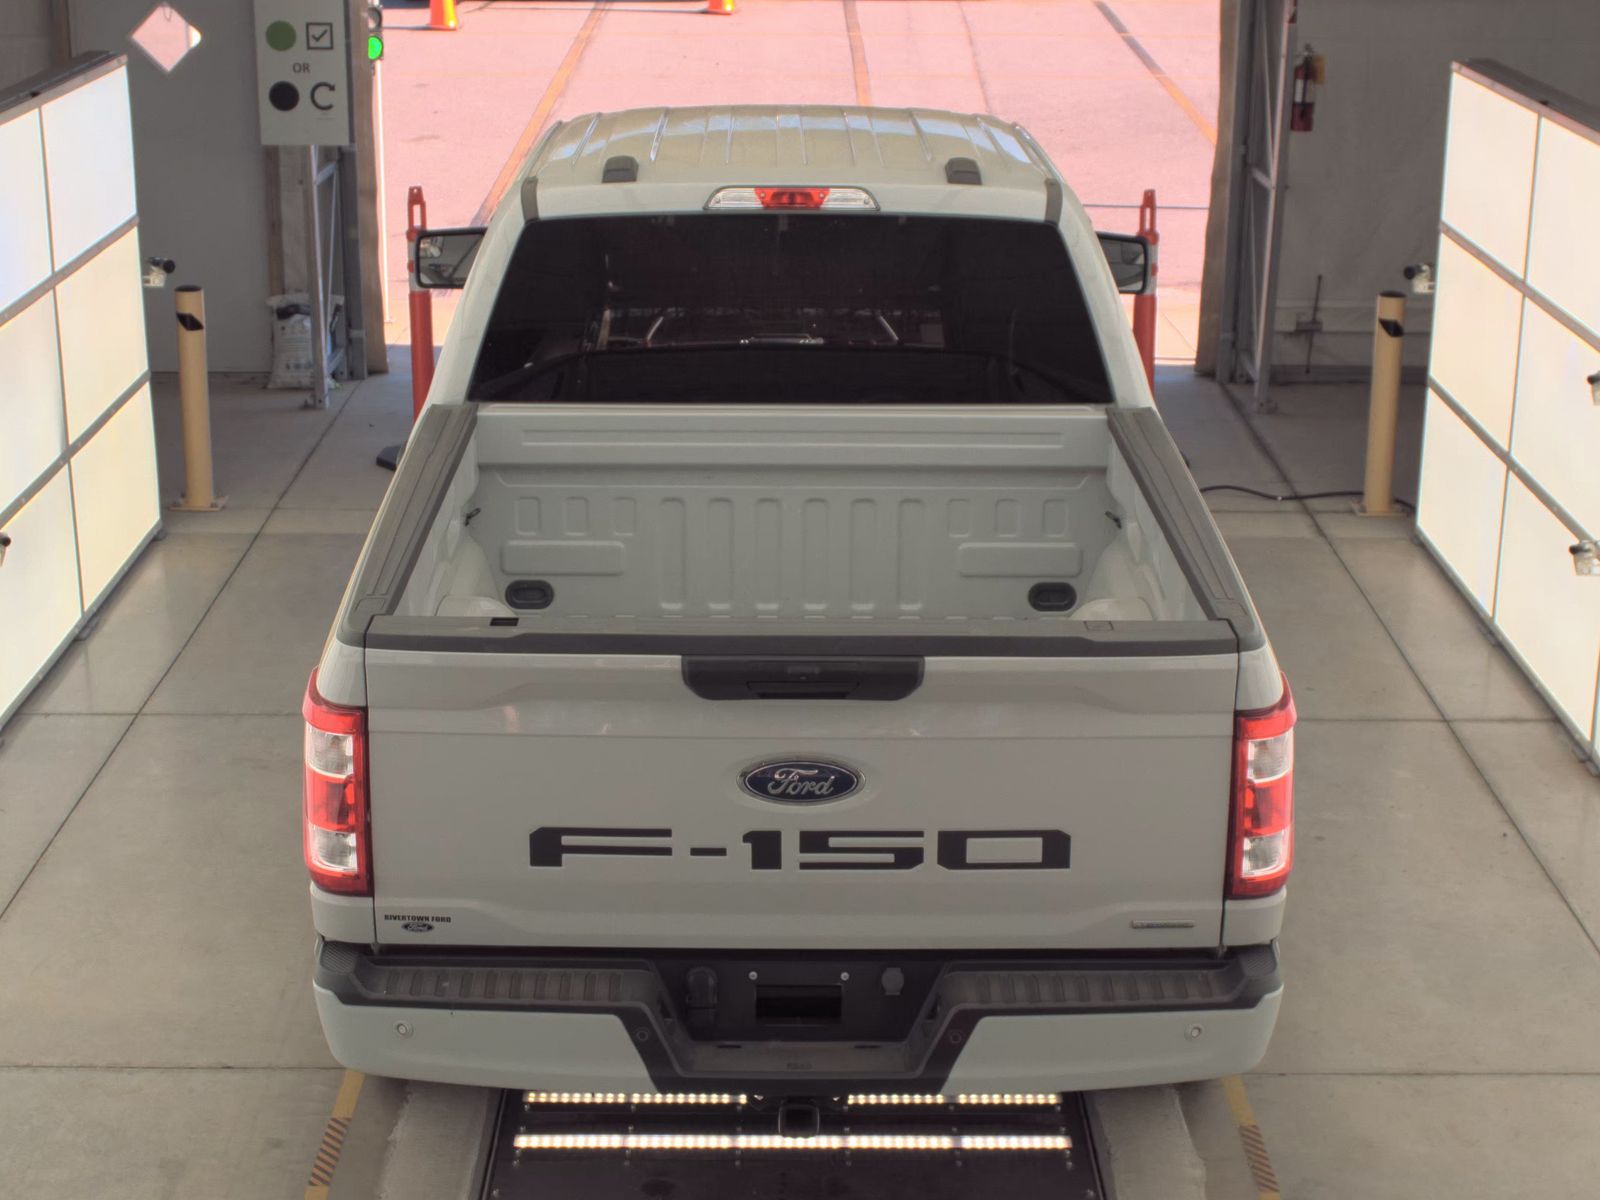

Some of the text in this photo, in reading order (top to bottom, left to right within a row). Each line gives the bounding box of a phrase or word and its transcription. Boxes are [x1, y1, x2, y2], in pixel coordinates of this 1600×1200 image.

[292, 62, 311, 73] OR
[767, 767, 835, 795] Ford
[529, 826, 1072, 870] F-150
[384, 914, 430, 922] RIVERTOWN
